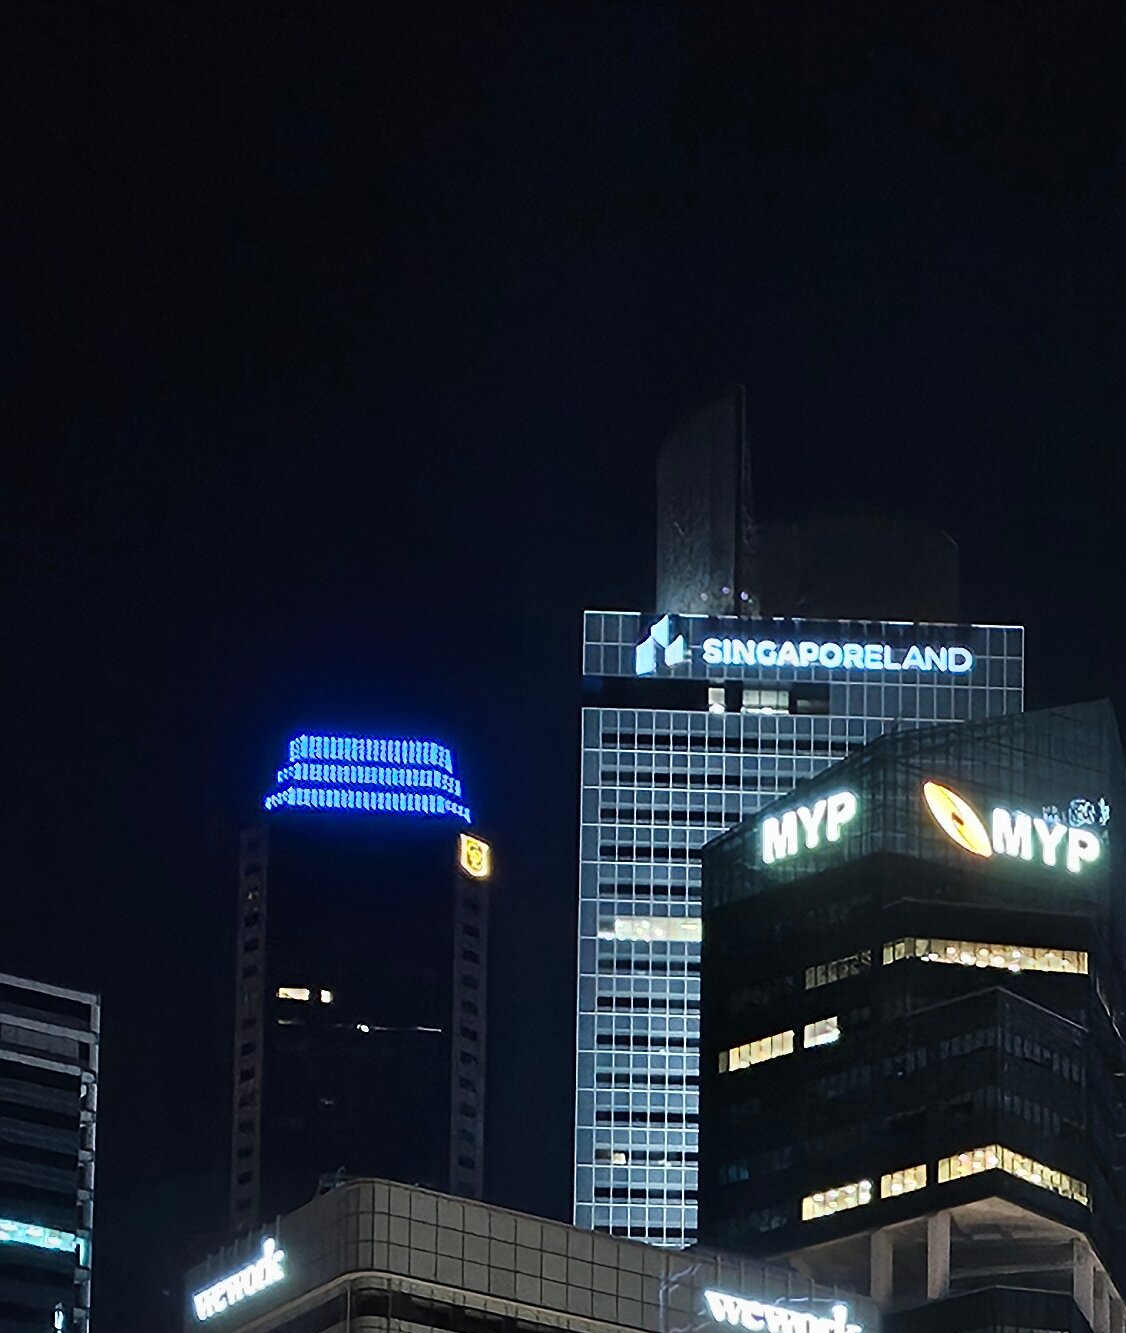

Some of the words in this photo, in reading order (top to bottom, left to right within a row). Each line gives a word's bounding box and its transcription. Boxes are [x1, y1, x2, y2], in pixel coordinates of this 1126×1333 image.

[702, 637, 973, 673] SINGAPORELAND
[761, 791, 858, 864] MYP
[992, 807, 1102, 874] MYP
